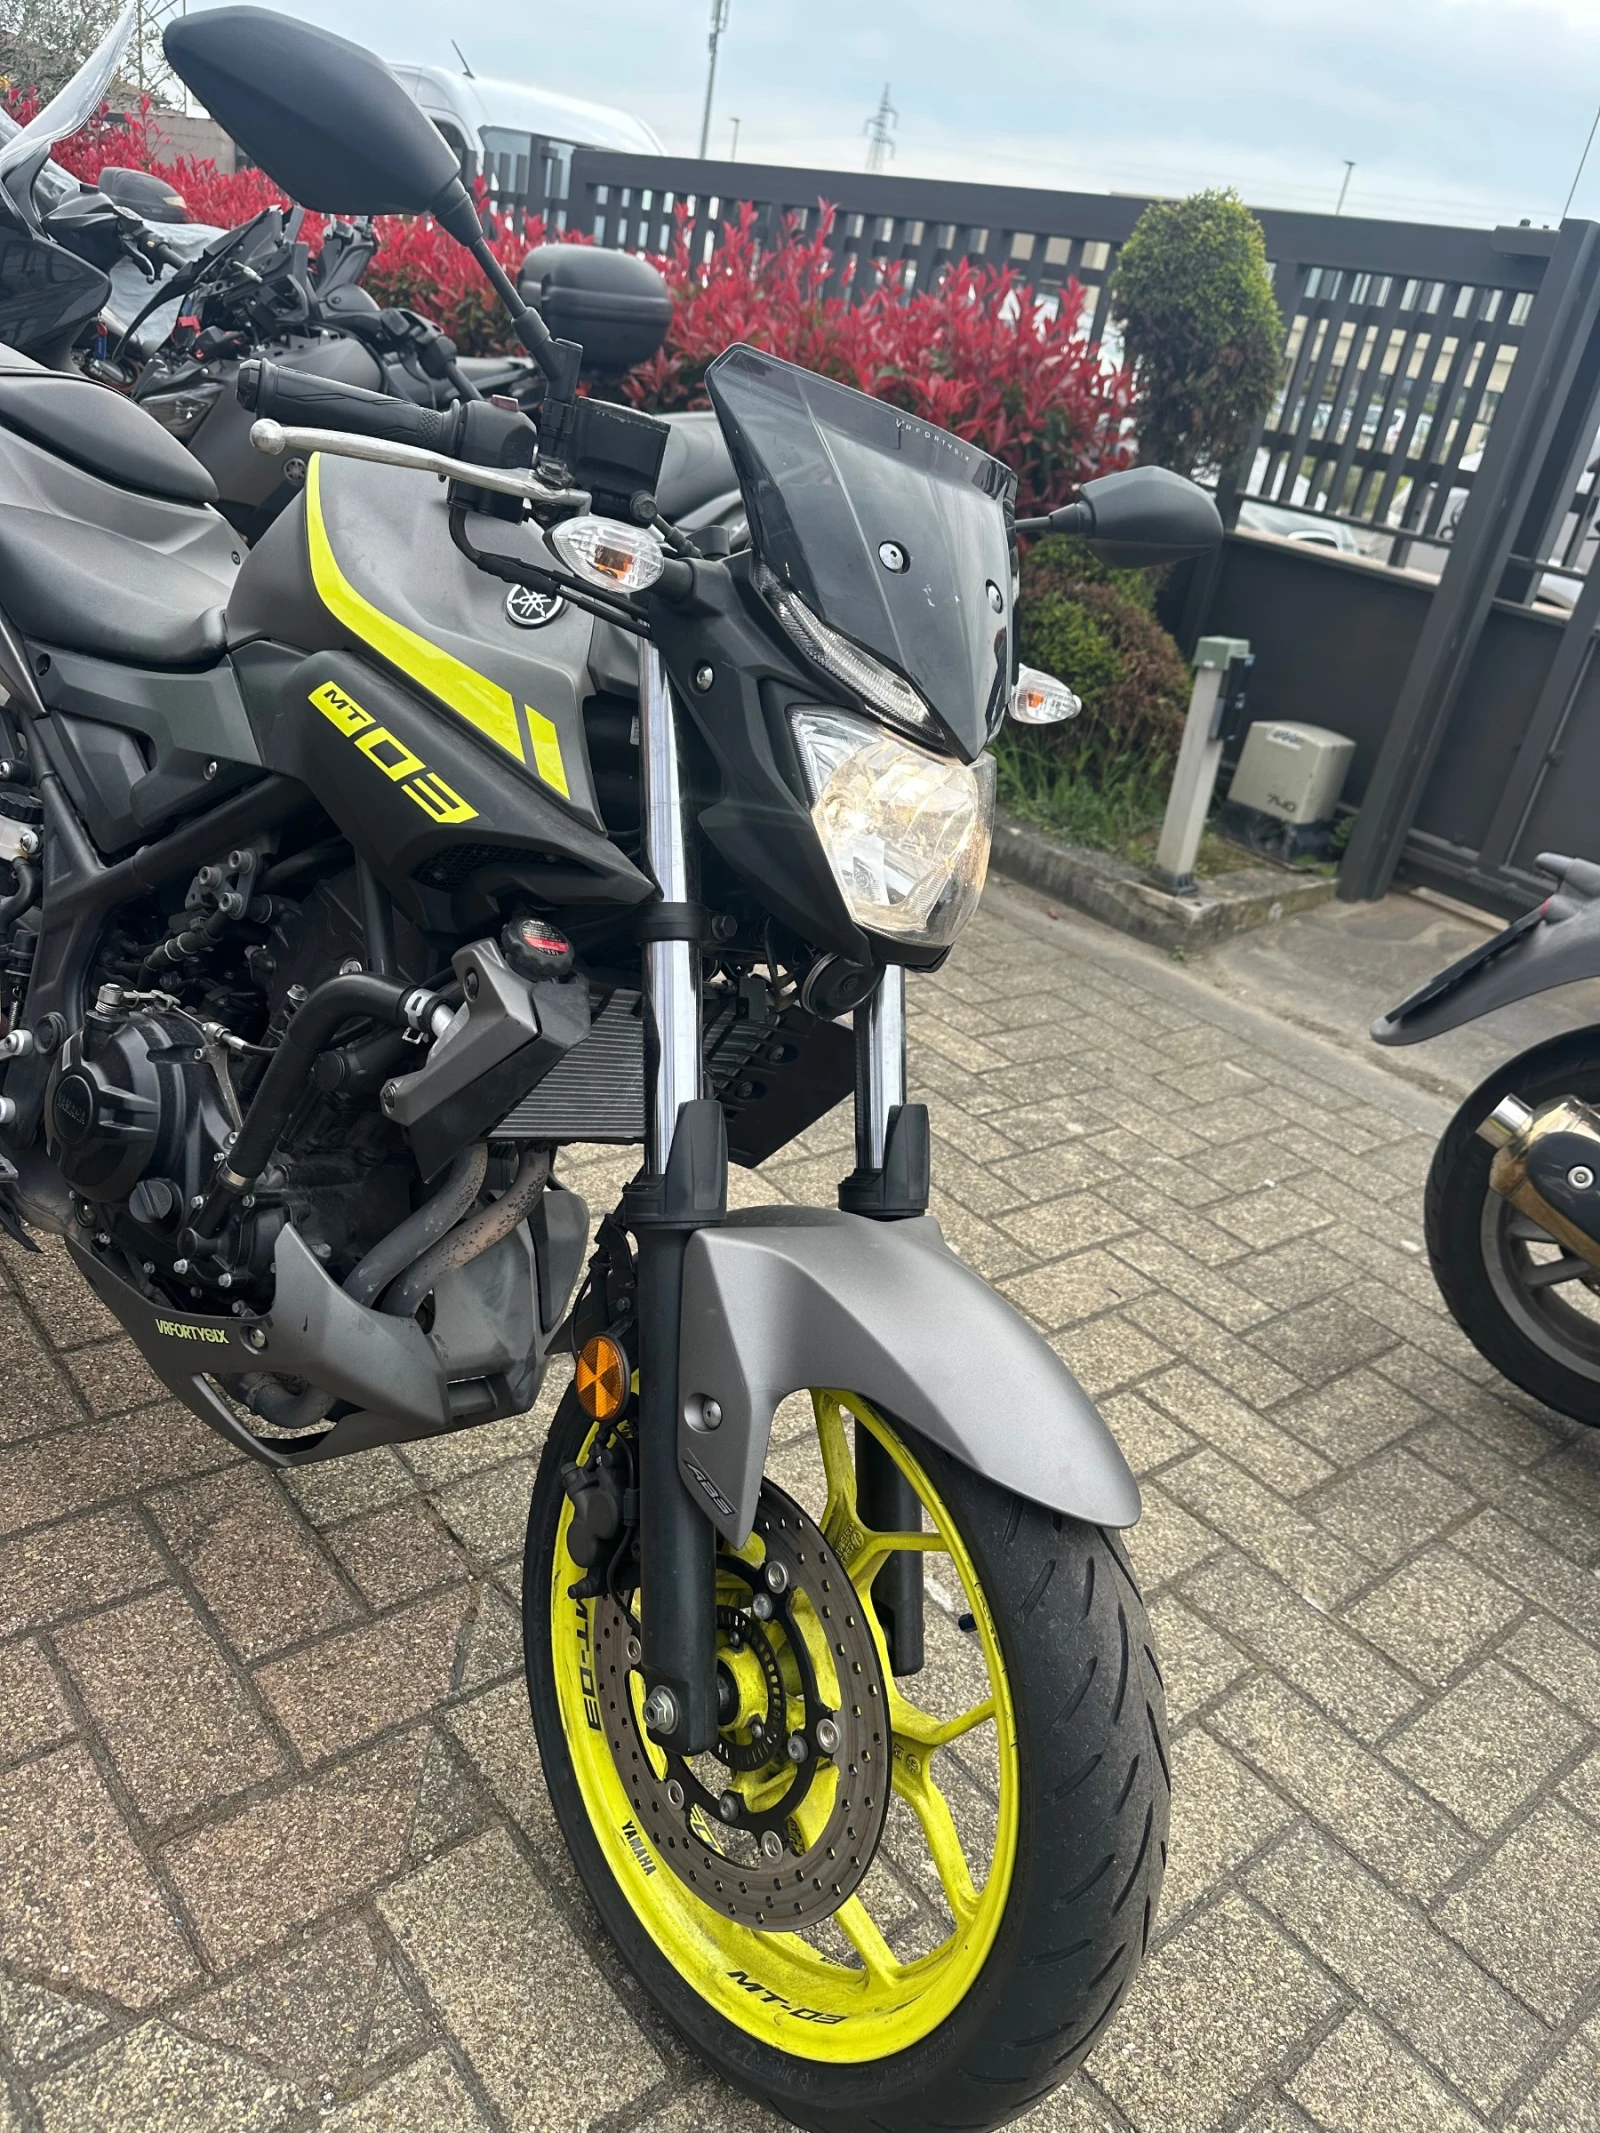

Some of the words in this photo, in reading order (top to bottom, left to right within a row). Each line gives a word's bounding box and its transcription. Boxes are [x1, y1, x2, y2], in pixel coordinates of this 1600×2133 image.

[323, 689, 368, 723] MT
[354, 726, 480, 824] 03
[155, 1318, 230, 1344] VRFORTYSIX
[681, 1459, 736, 1515] ABS
[621, 1820, 657, 1876] YAMAHA
[726, 1970, 850, 2025] MT-03
